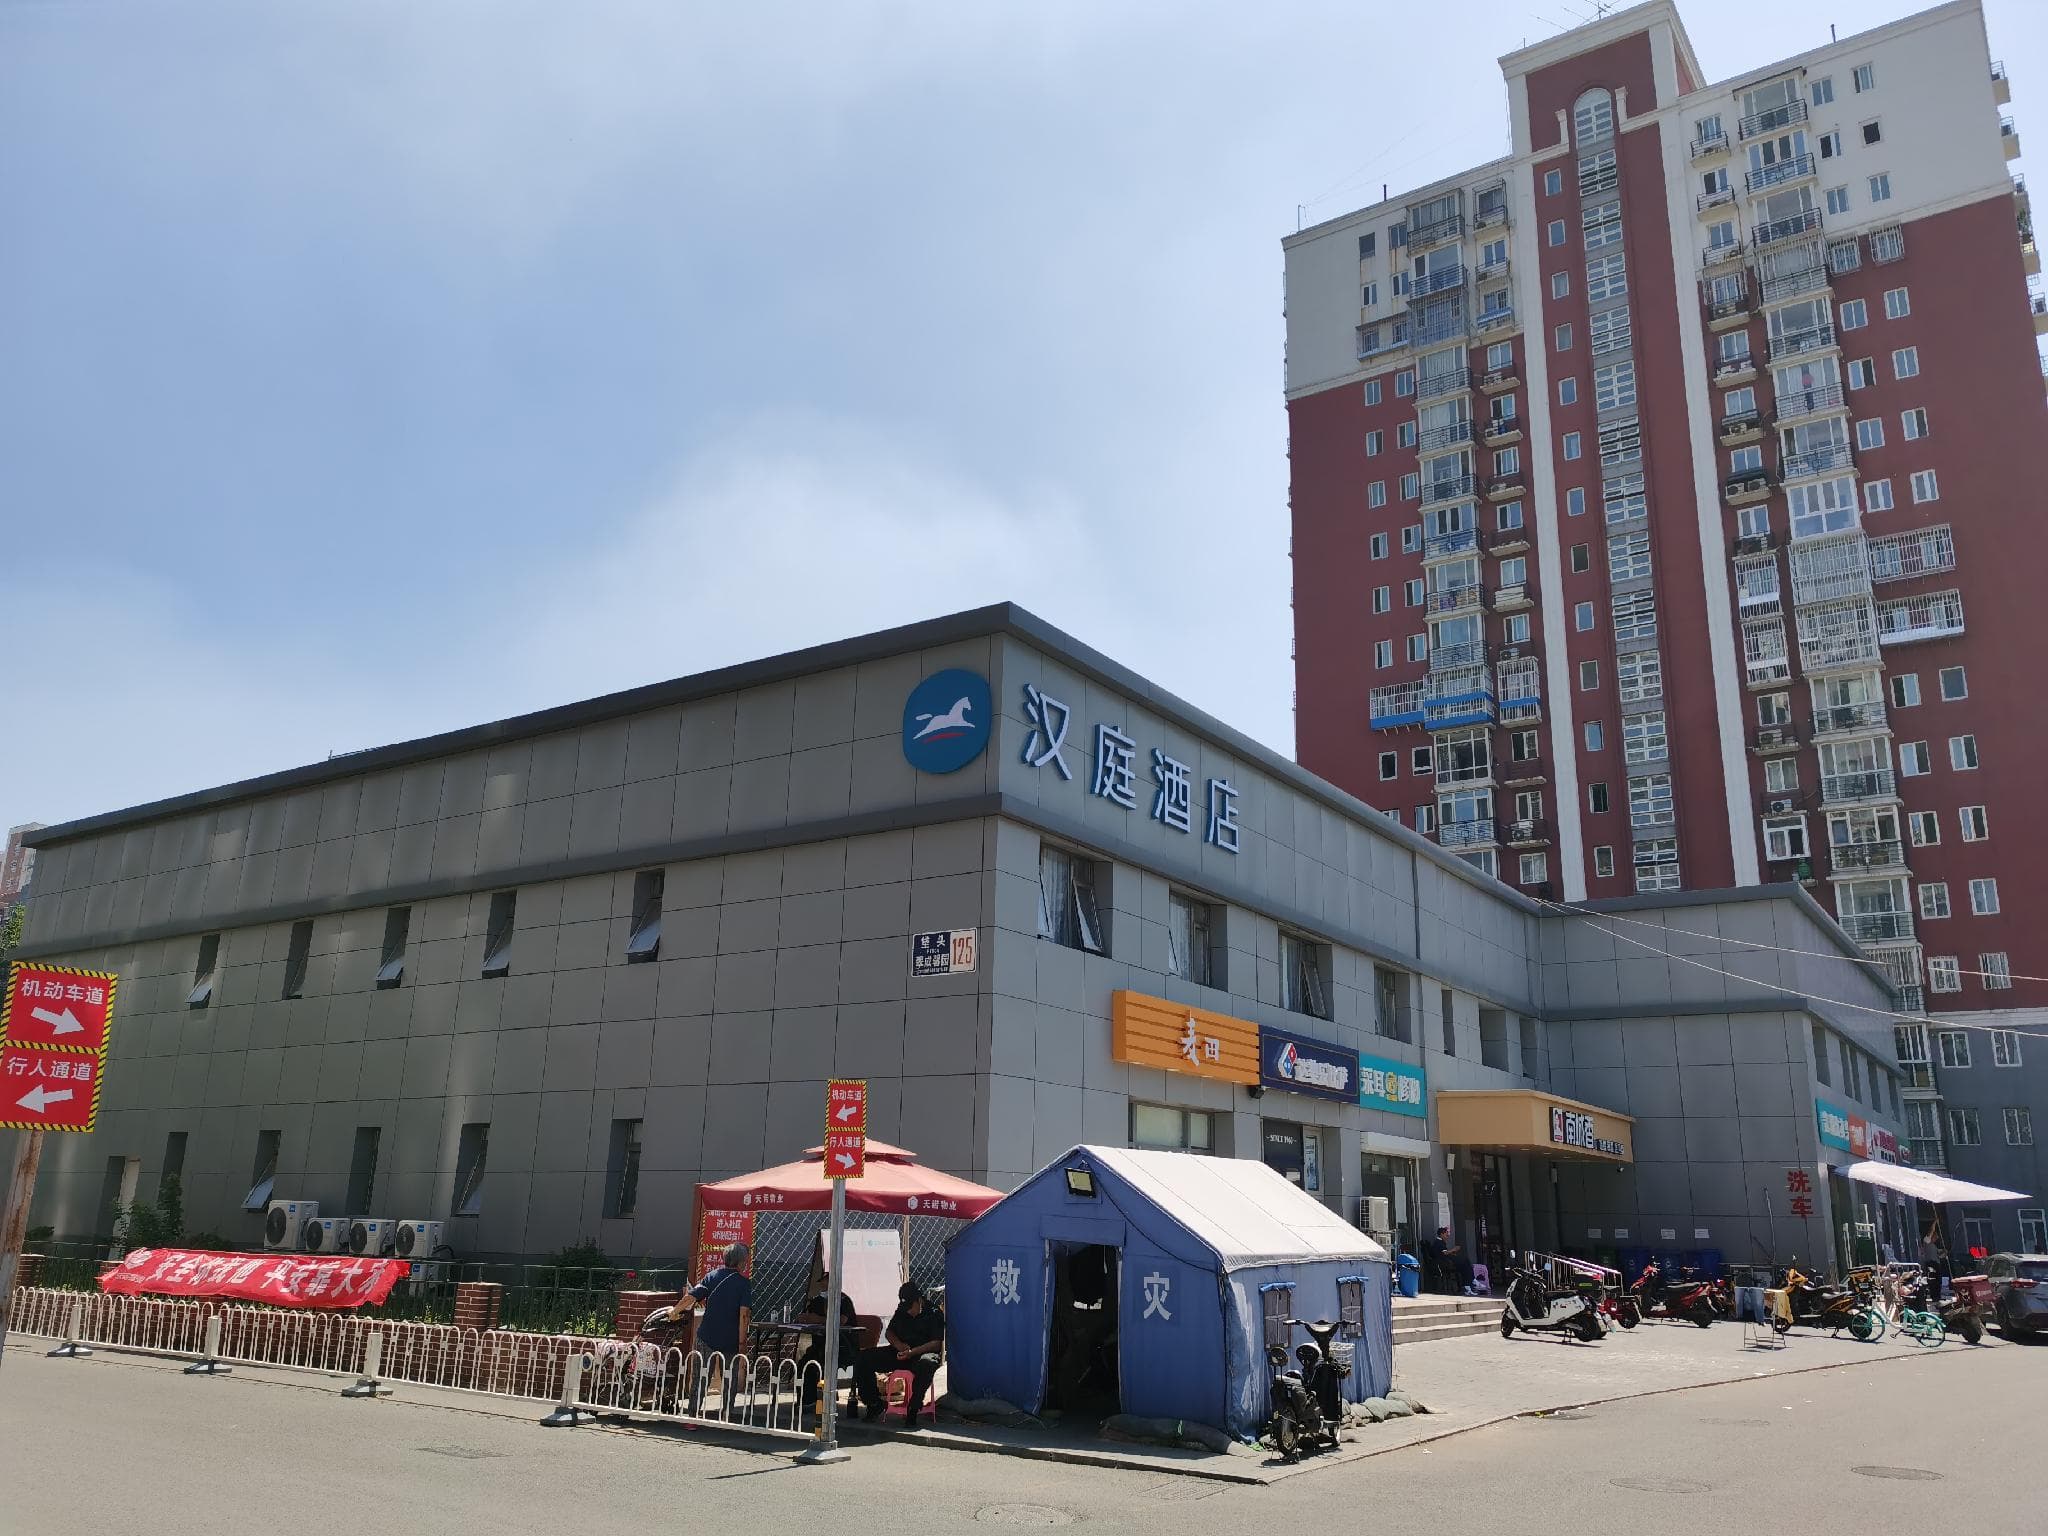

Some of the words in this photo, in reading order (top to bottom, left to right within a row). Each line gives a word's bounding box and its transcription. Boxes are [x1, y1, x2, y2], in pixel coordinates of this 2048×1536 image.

[1022, 683, 1239, 854] 汉庭酒店
[952, 937, 973, 965] 125
[21, 979, 104, 1005] 机动车道
[1180, 1016, 1220, 1067] 麦田
[7, 1056, 93, 1080] 行人通道
[831, 1089, 863, 1101] 机动车道
[829, 1136, 862, 1148] 行人通道
[1565, 1111, 1595, 1149] 南城香
[1786, 1170, 1814, 1219] 洗车
[990, 1258, 1021, 1305] 救
[1143, 1271, 1172, 1321] 灾
